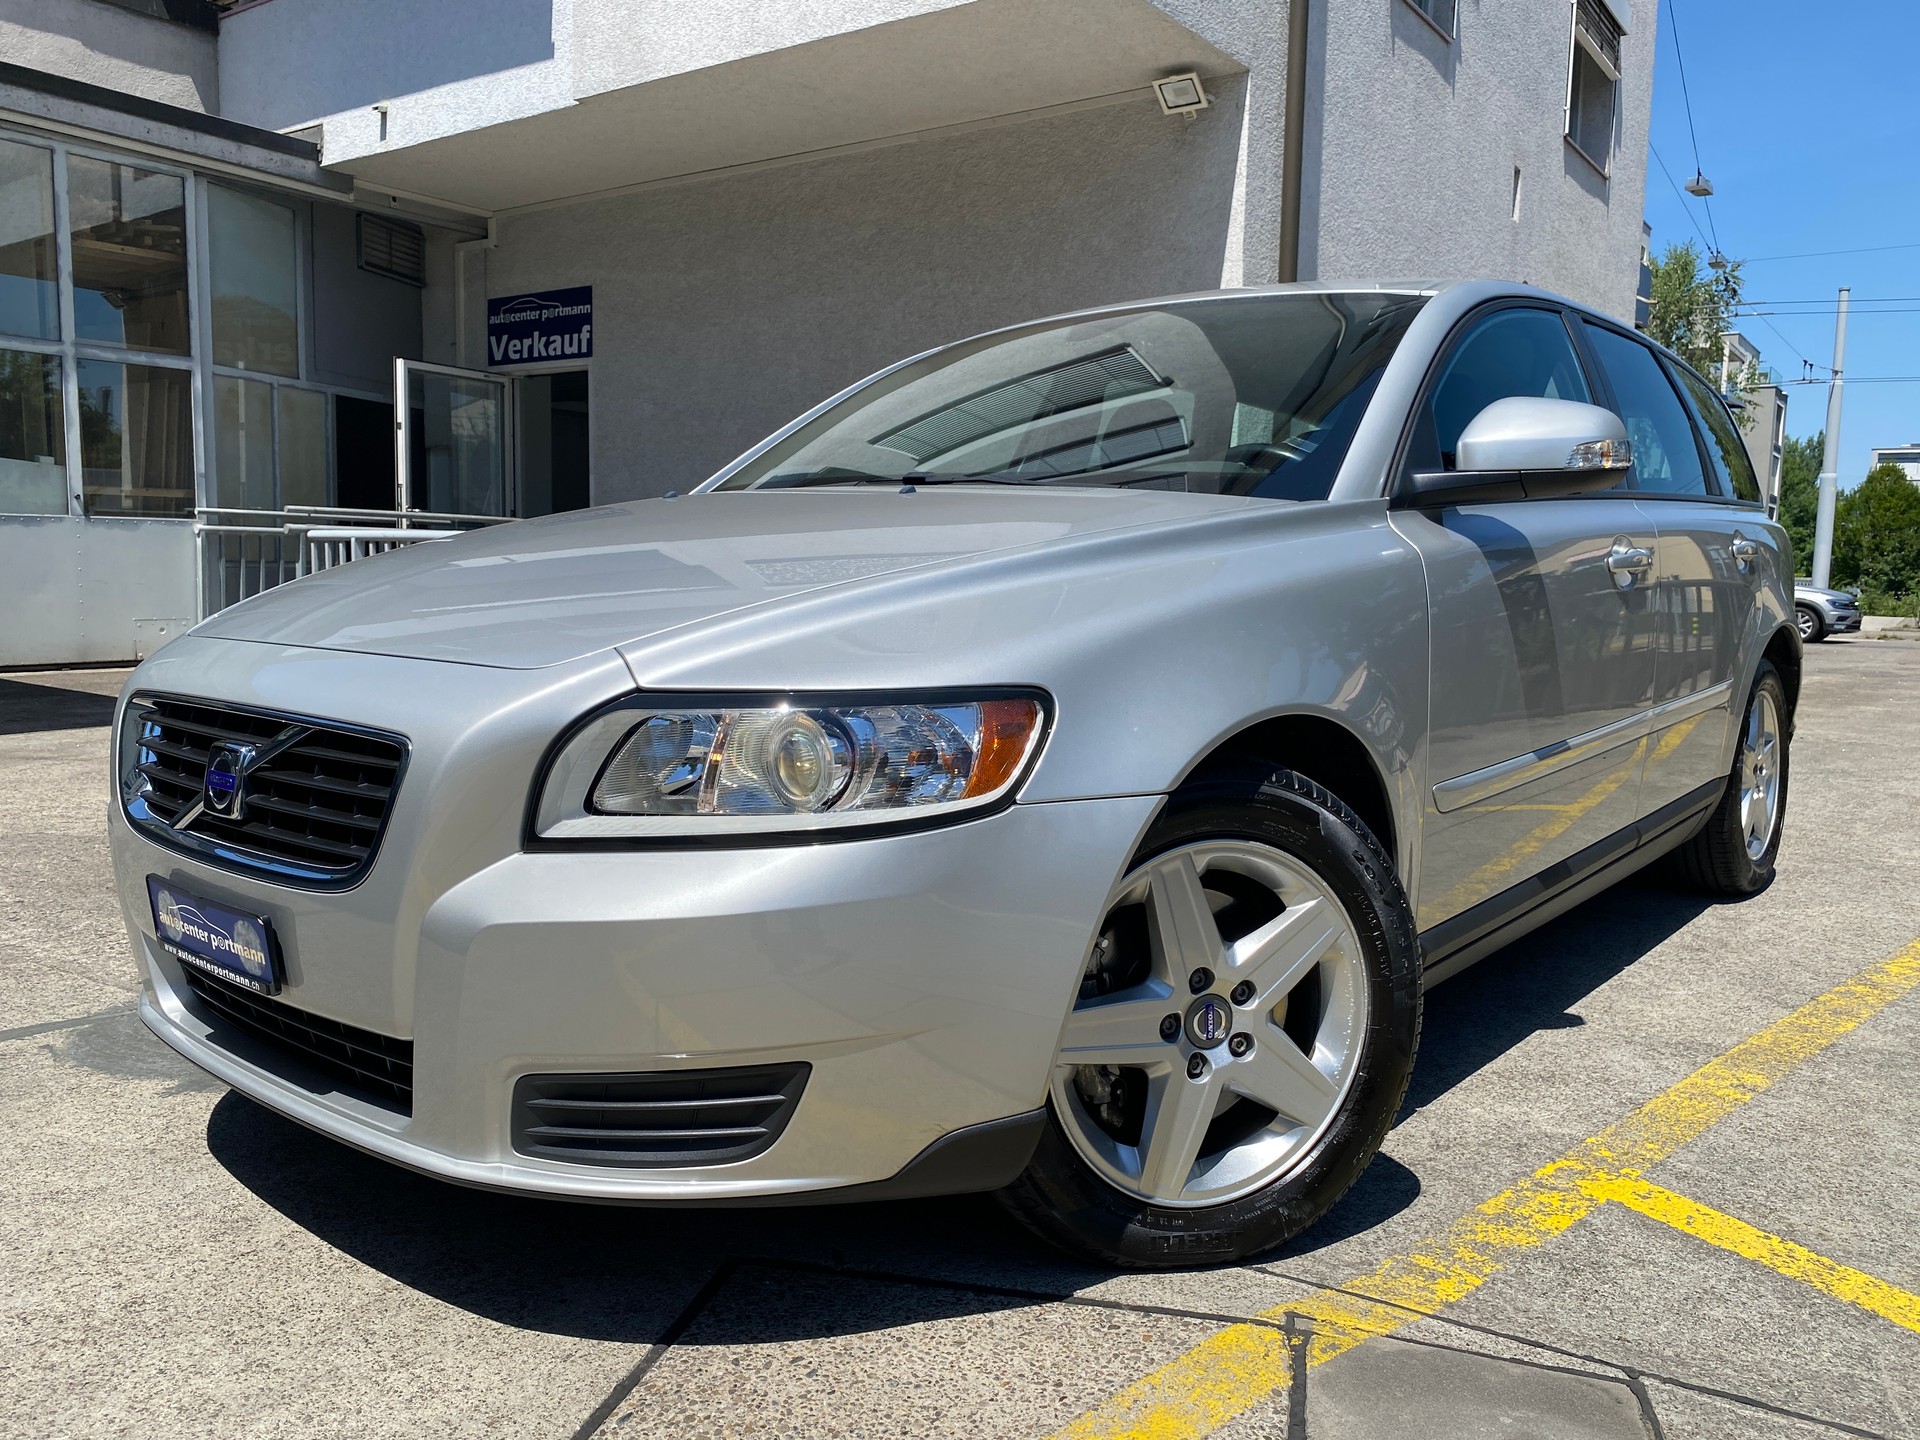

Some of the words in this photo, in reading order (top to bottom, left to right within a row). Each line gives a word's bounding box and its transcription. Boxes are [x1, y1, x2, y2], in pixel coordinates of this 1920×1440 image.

[489, 310, 540, 325] autocenter
[541, 304, 591, 321] portmann
[489, 324, 591, 361] Verkauf
[159, 911, 209, 943] autocenter
[210, 933, 266, 965] portmann
[163, 943, 260, 991] www.autocenterportmann.ch
